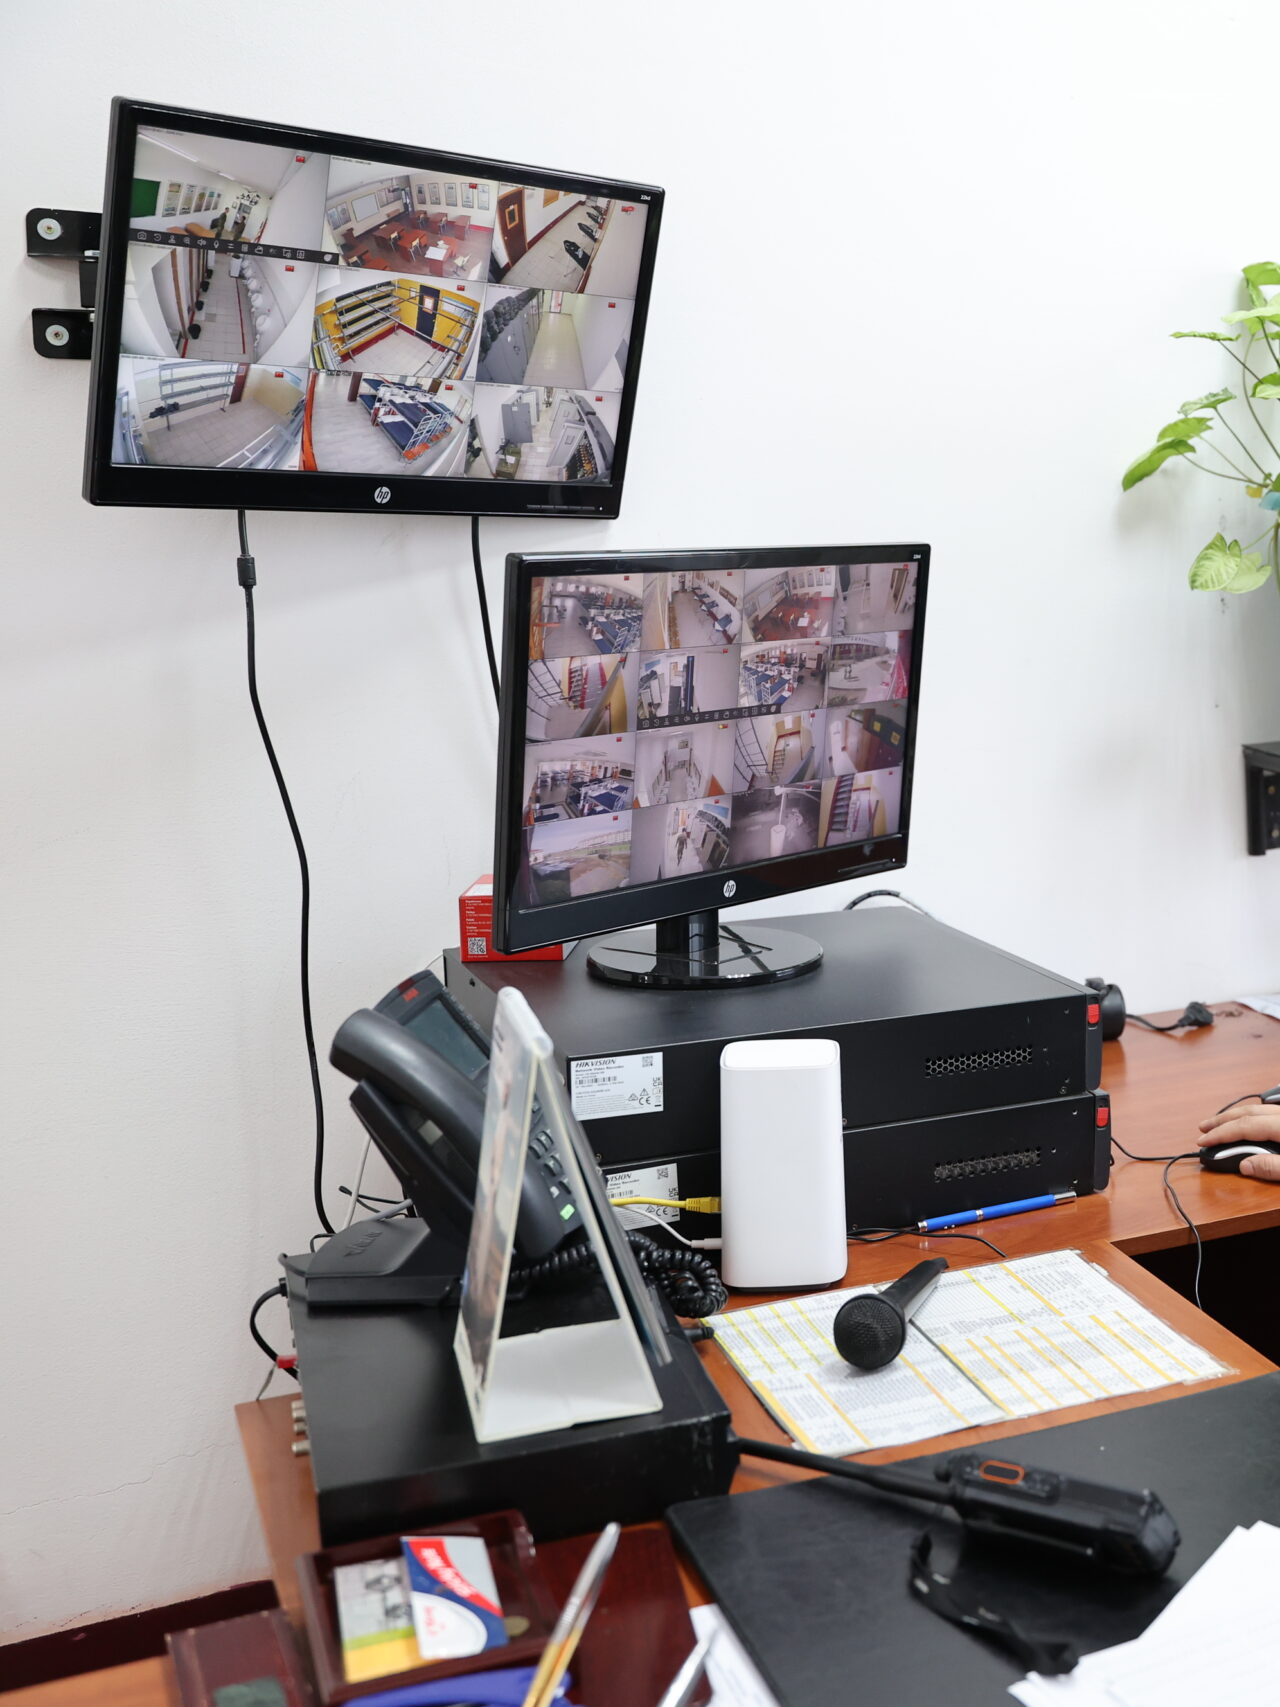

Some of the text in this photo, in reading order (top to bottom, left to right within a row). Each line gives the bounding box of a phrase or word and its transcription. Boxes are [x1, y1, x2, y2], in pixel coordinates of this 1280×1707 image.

[374, 486, 392, 504] hp
[723, 880, 737, 898] hp
[575, 1058, 617, 1069] HIKVISION
